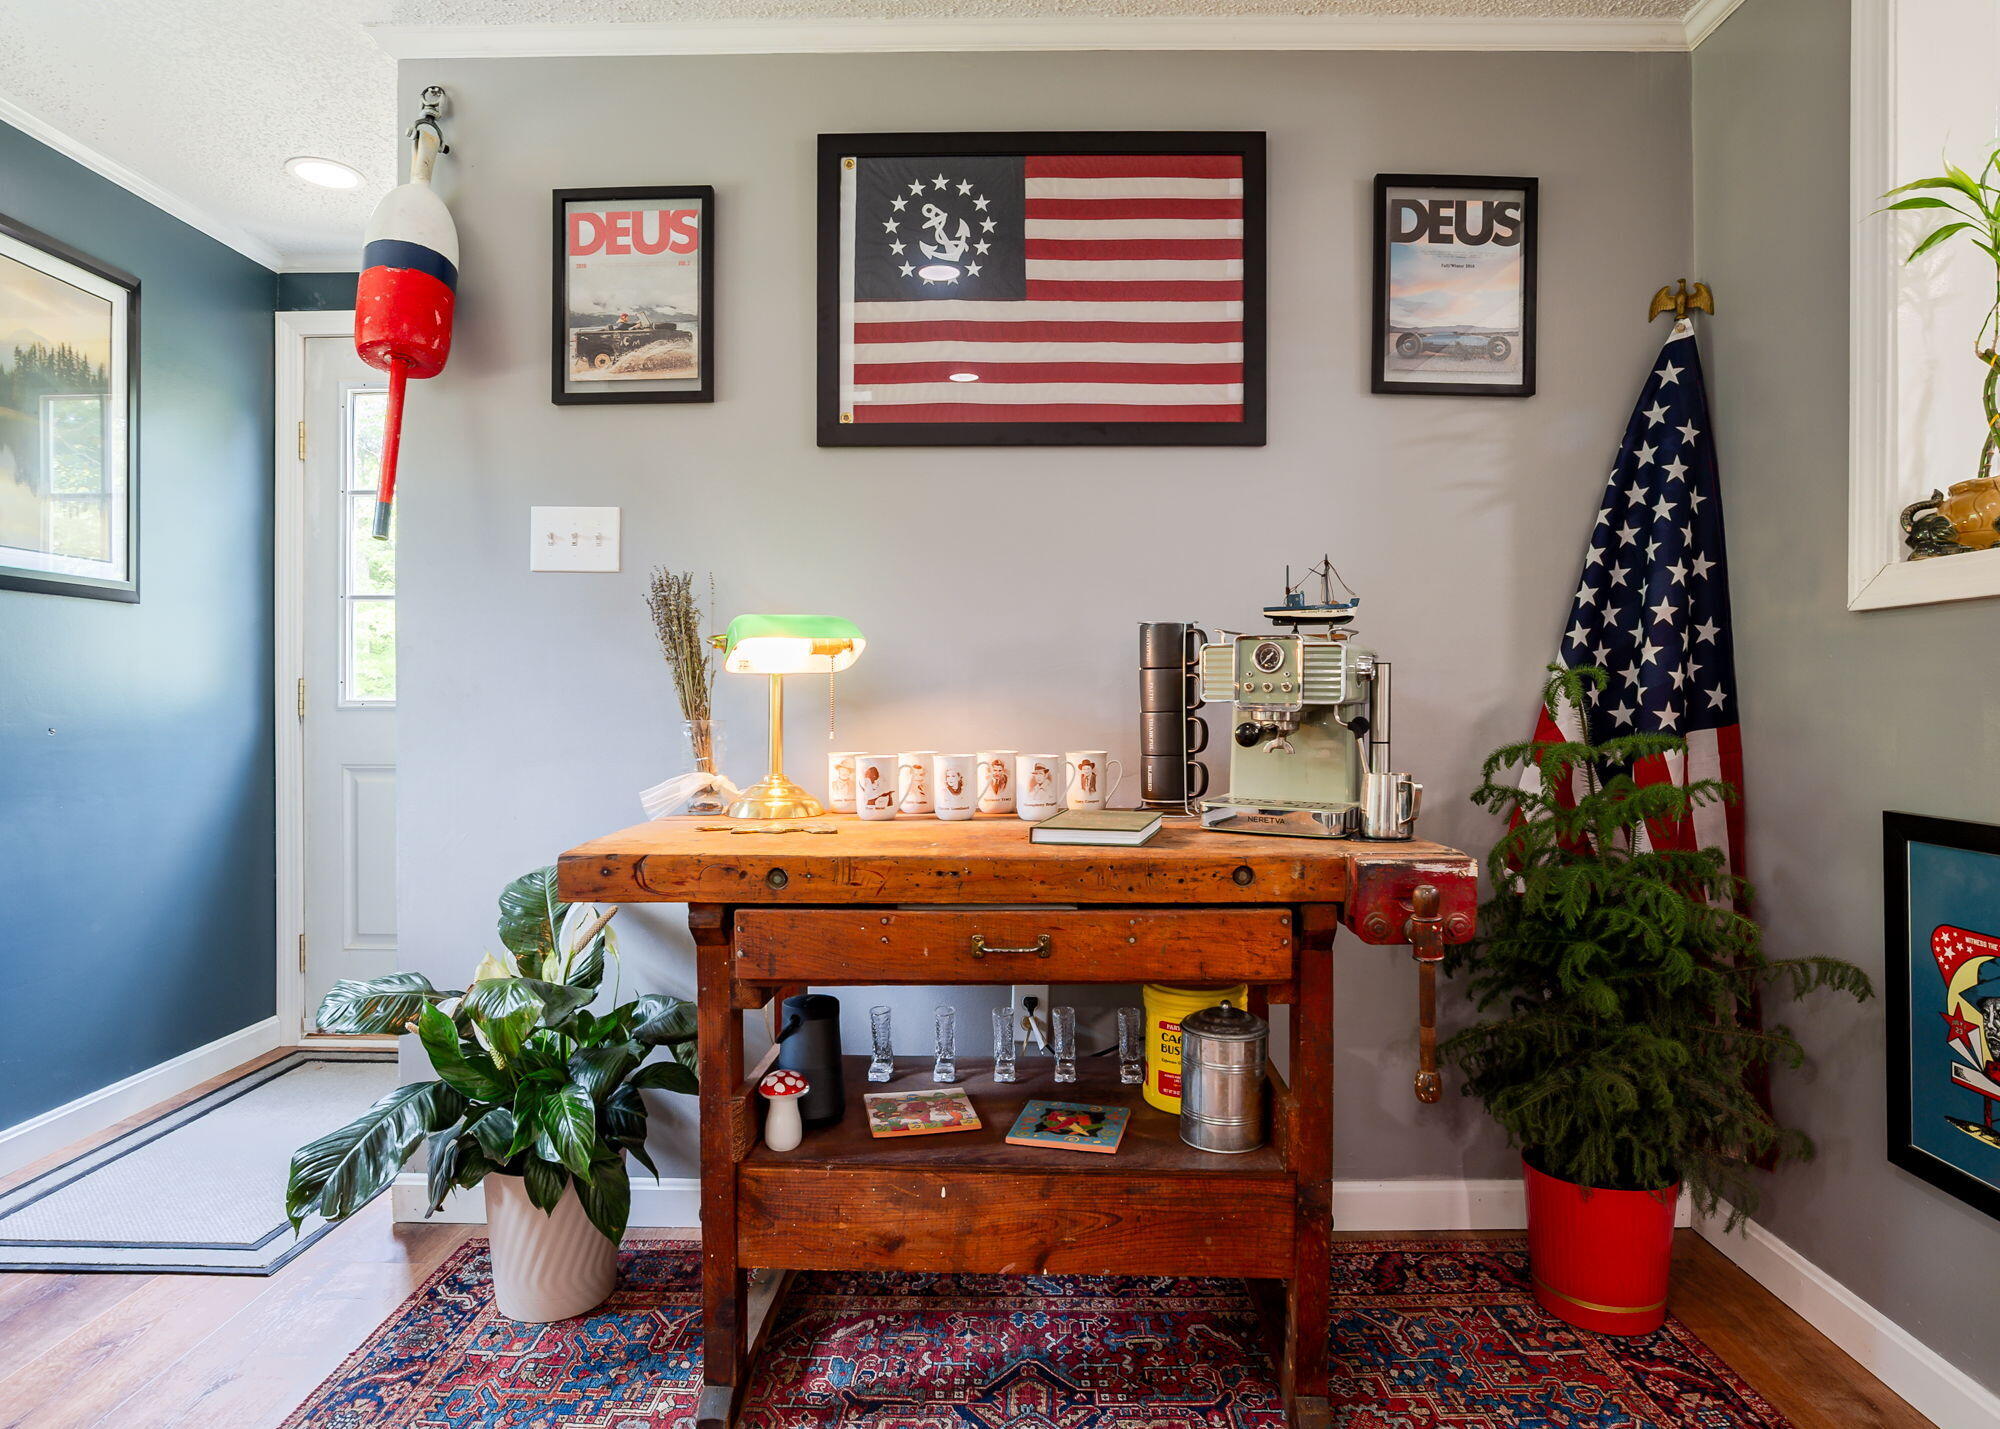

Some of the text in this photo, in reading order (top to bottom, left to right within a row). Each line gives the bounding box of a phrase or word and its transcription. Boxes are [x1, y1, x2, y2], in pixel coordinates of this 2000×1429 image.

[1391, 199, 1521, 247] DEUS
[569, 209, 698, 256] DEUS
[1247, 815, 1286, 825] NERETVA
[1965, 936, 1999, 952] WITNESS THE
[1161, 1032, 1182, 1044] CAF
[1161, 1044, 1182, 1055] BUS
